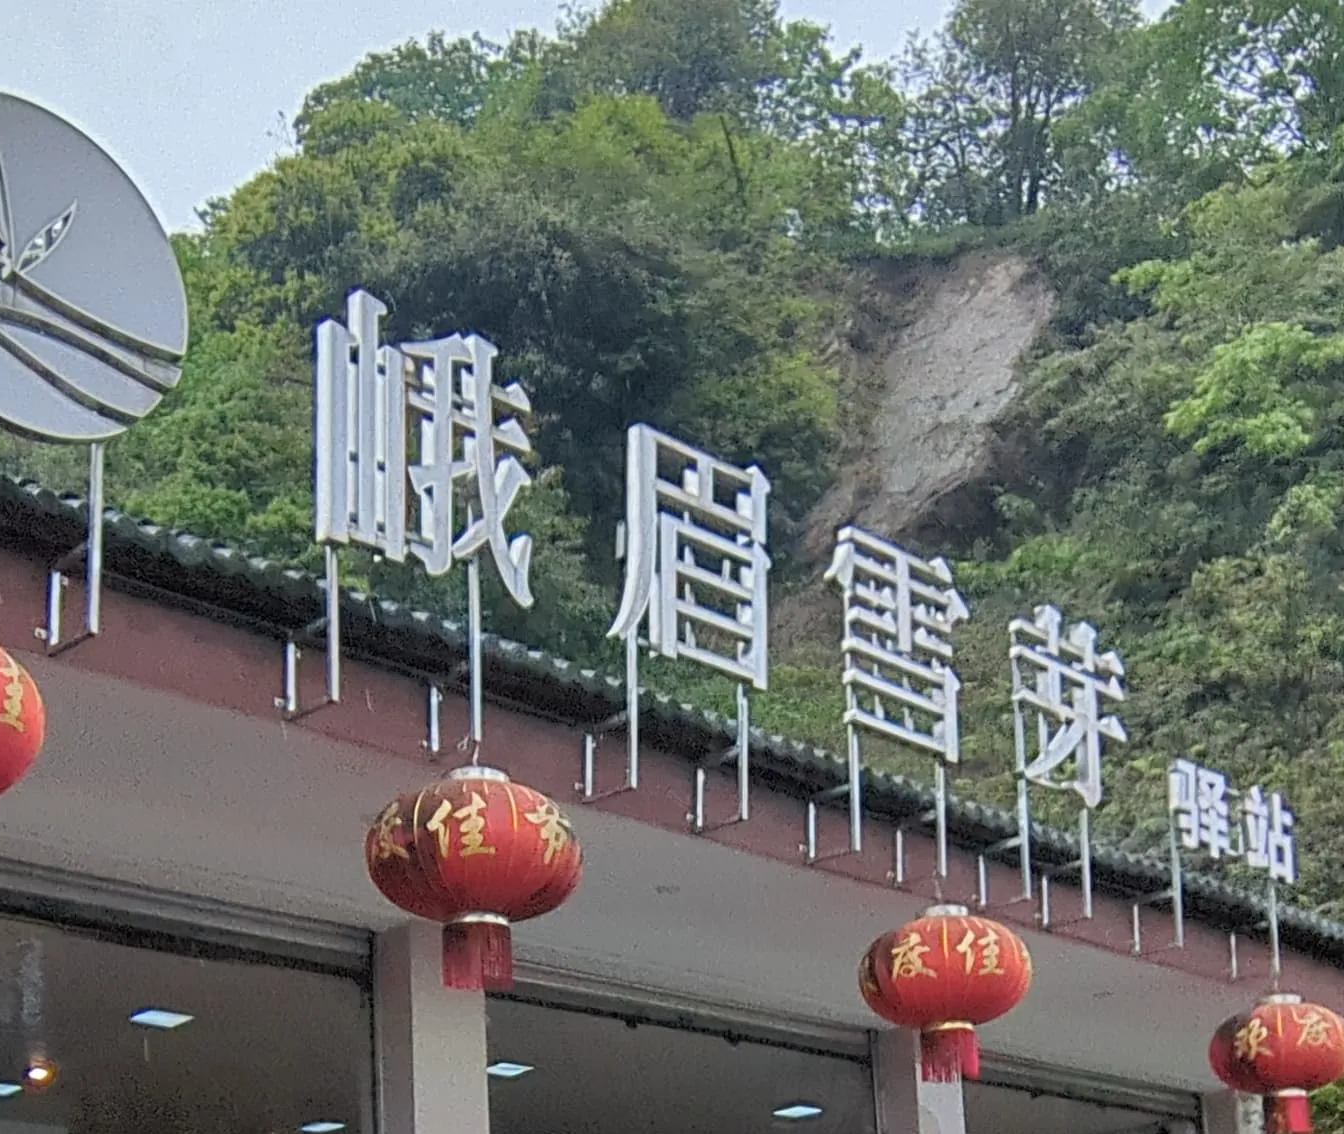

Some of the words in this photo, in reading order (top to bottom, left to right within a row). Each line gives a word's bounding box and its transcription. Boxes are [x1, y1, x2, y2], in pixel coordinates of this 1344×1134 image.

[313, 287, 1127, 808] 峨眉雪芽
[1168, 757, 1296, 885] 驿站
